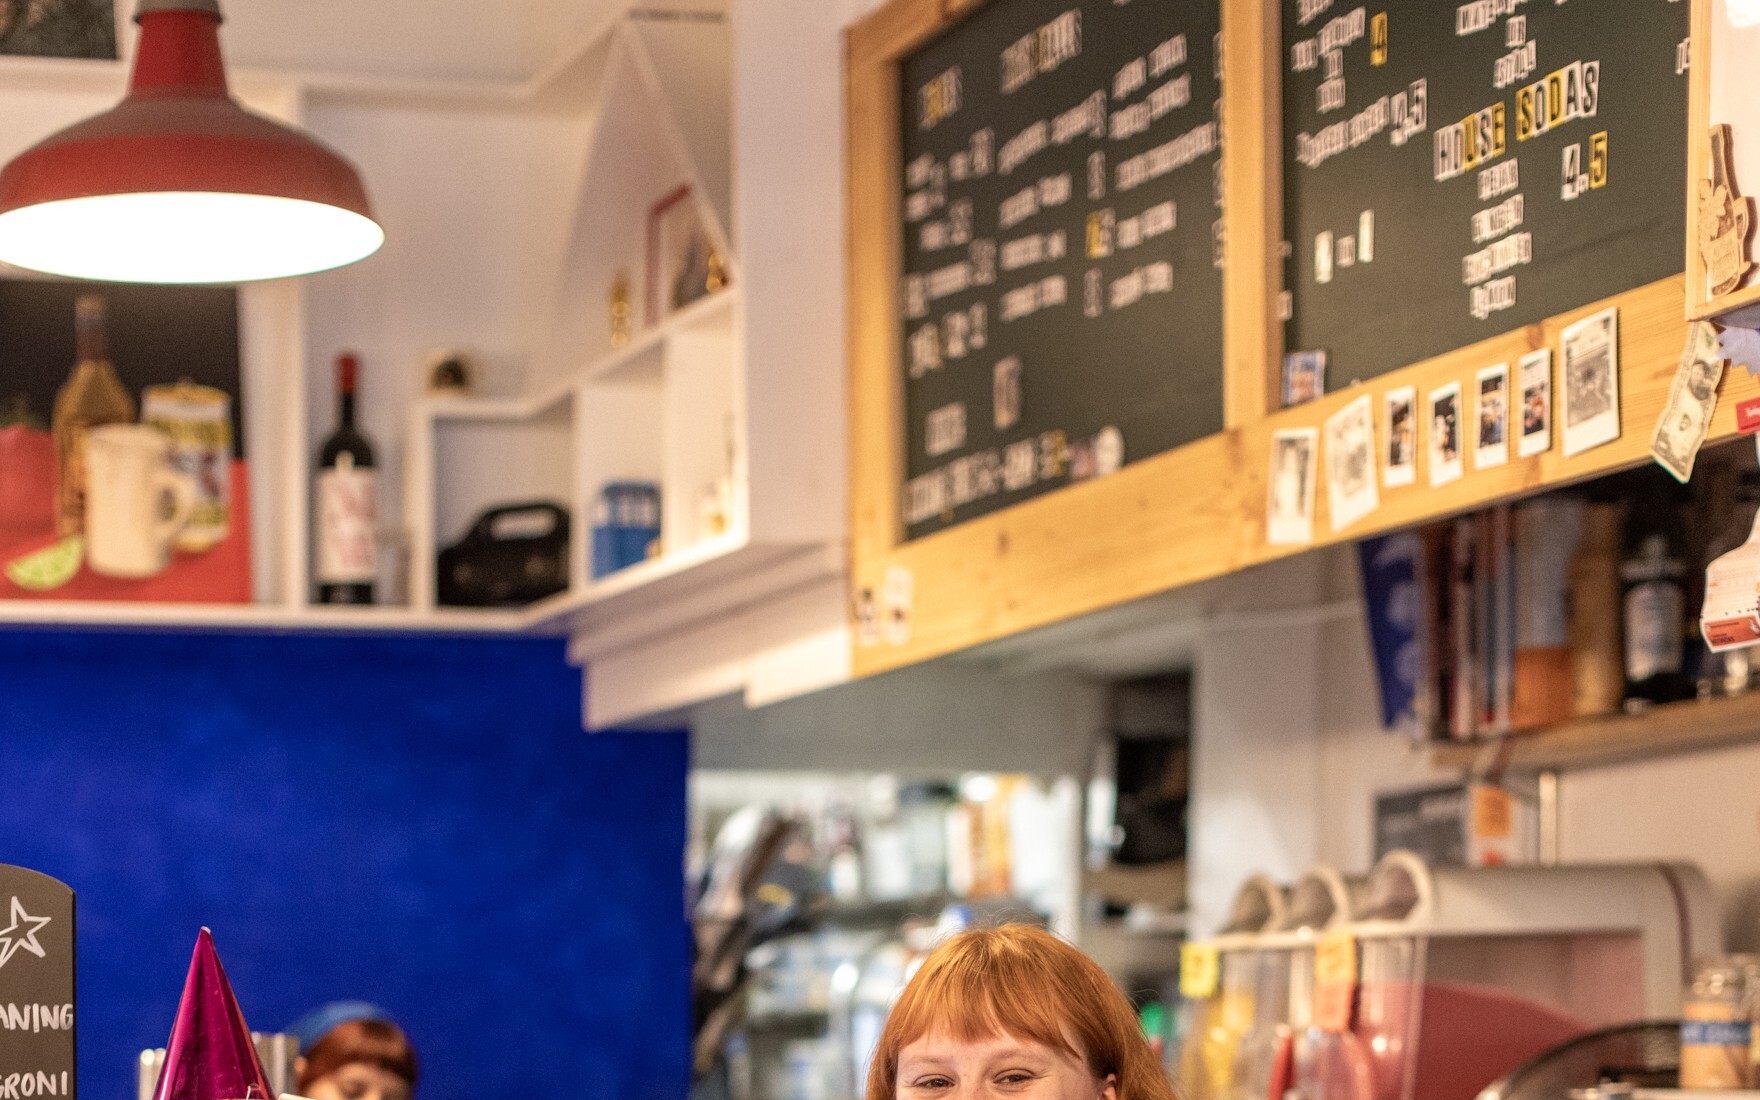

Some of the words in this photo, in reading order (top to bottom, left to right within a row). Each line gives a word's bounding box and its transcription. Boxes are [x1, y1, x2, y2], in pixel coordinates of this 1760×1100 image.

[1434, 102, 1505, 181] HOUSE
[1516, 61, 1599, 140] SODAS
[1562, 132, 1606, 199] 4.5
